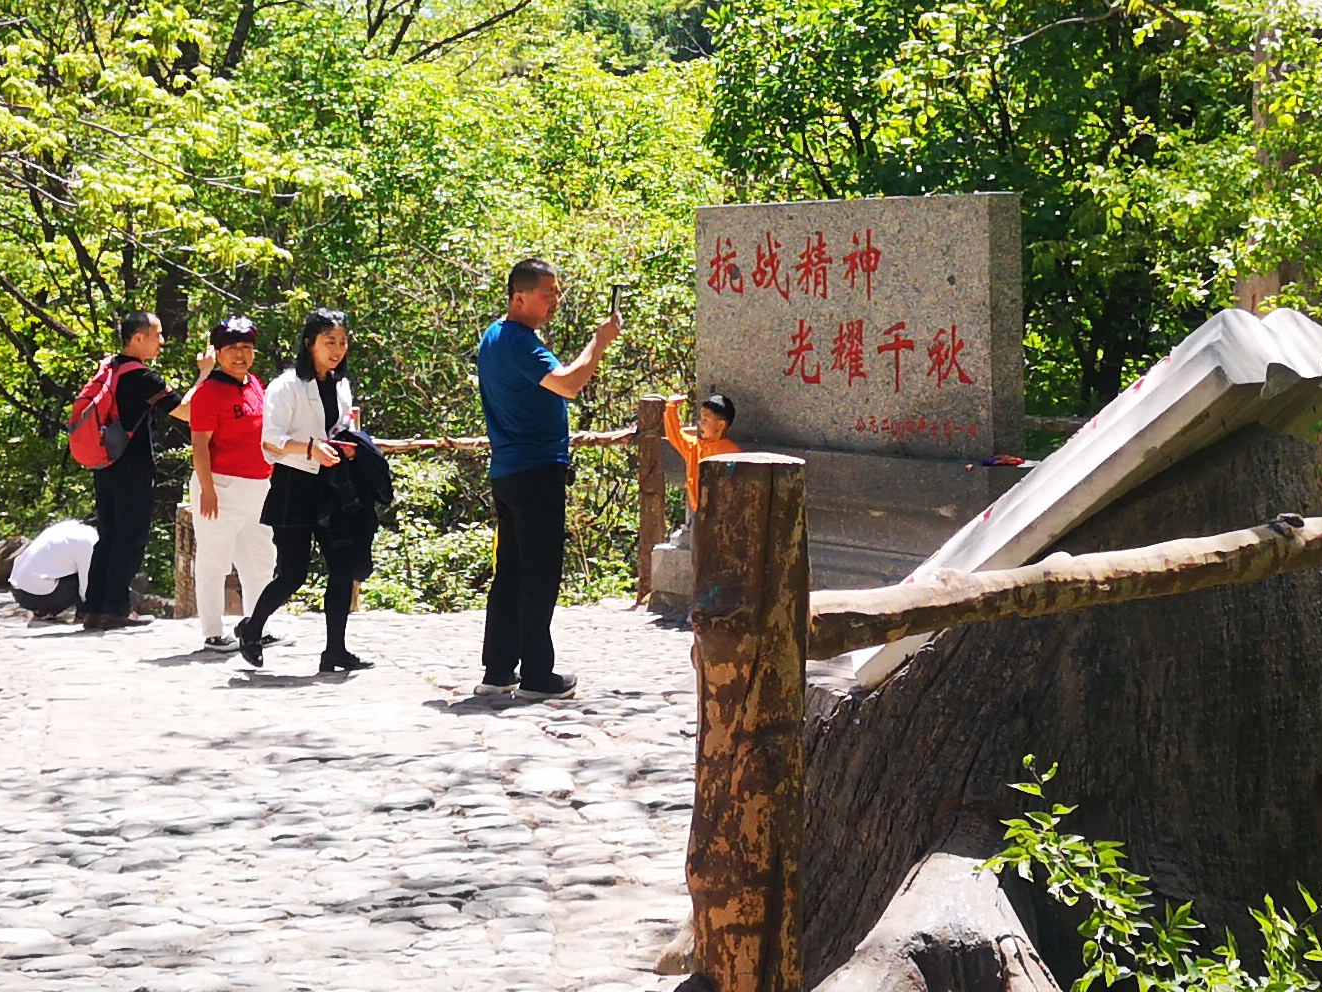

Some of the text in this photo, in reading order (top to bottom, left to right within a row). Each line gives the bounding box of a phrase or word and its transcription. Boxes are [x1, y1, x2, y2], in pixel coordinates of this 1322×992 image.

[707, 228, 882, 301] 抗战精神
[785, 319, 974, 393] 光耀千秋
